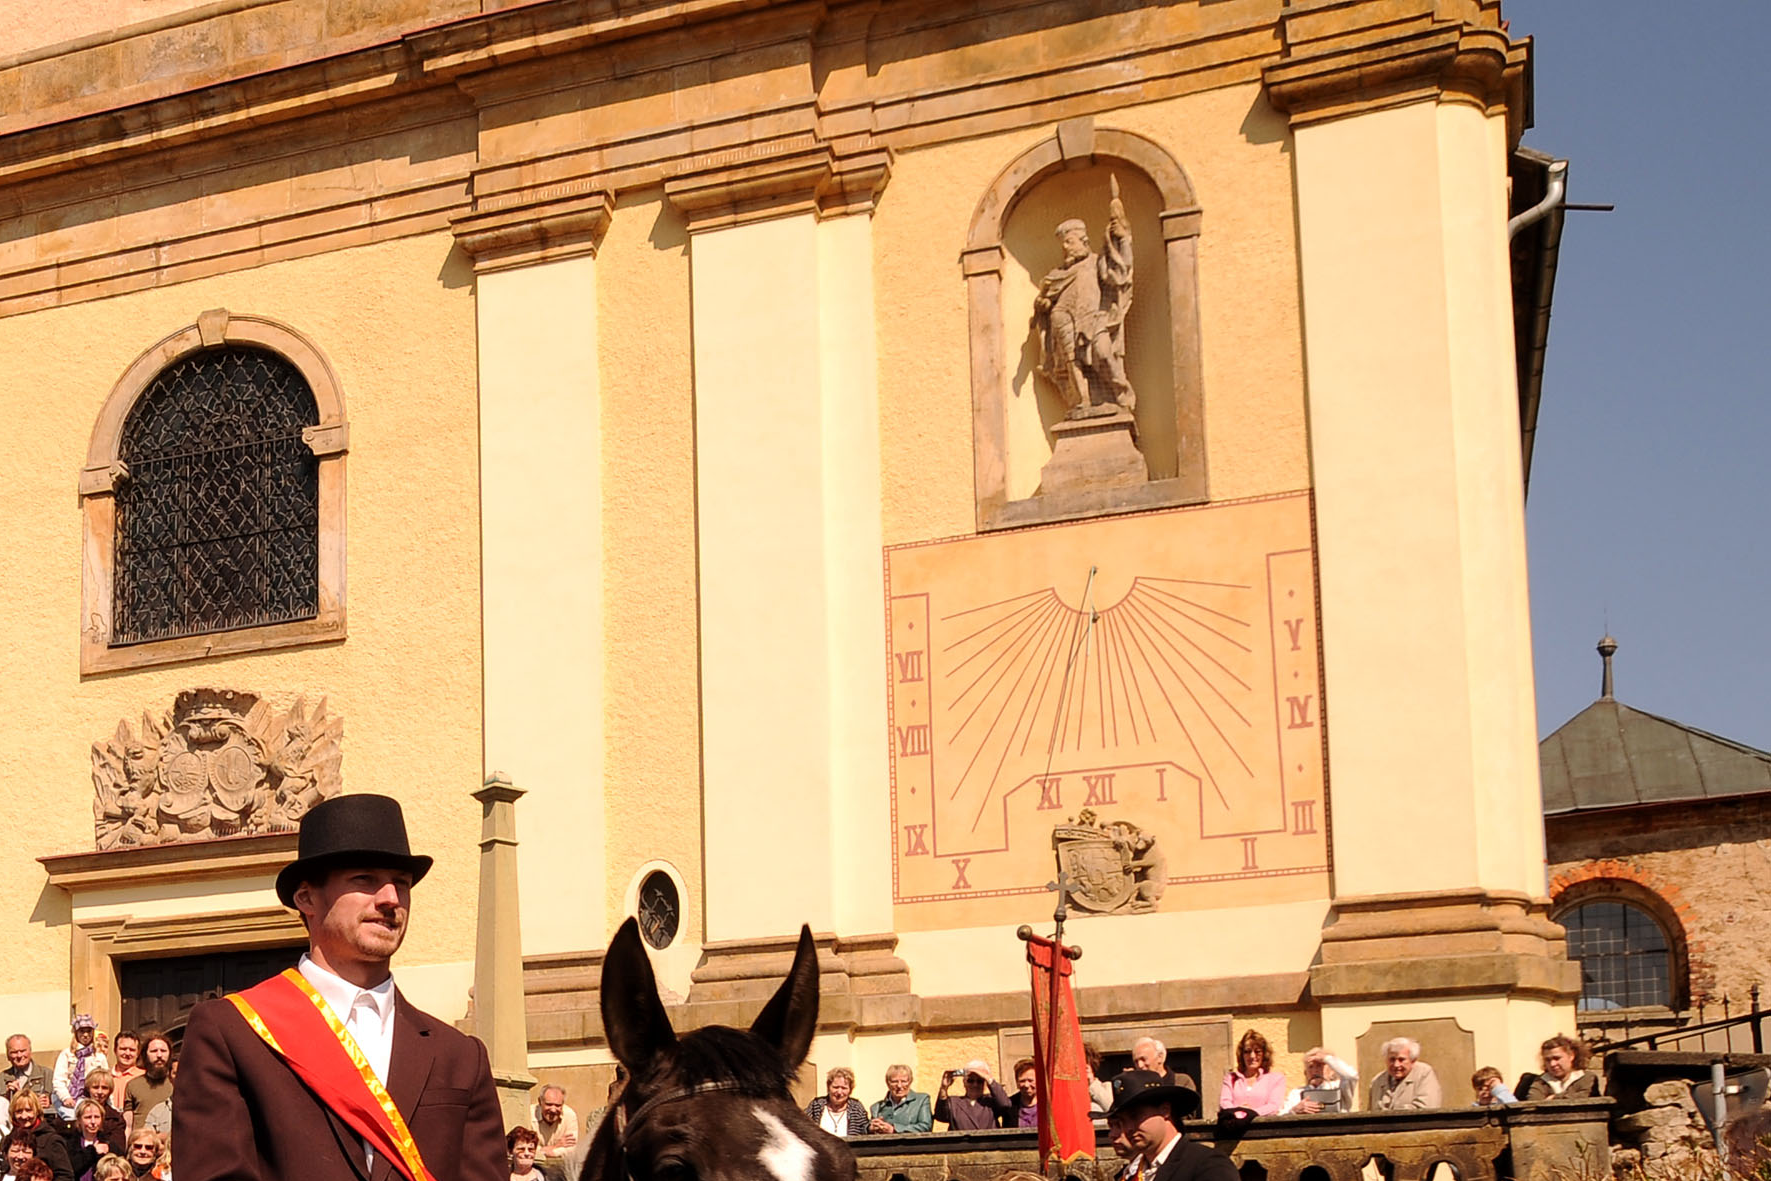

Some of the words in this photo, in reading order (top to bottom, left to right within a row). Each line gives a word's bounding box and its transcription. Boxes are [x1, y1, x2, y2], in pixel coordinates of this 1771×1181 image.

[1284, 618, 1304, 651] V
[894, 651, 924, 683] VII
[1286, 695, 1314, 729] IV
[897, 724, 929, 757] VIII
[1036, 777, 1063, 811] XI
[1082, 773, 1118, 806] XII
[1155, 768, 1168, 801] I
[1291, 800, 1317, 835] III
[904, 824, 929, 857] IX
[1240, 837, 1259, 870] II
[951, 858, 971, 890] X
